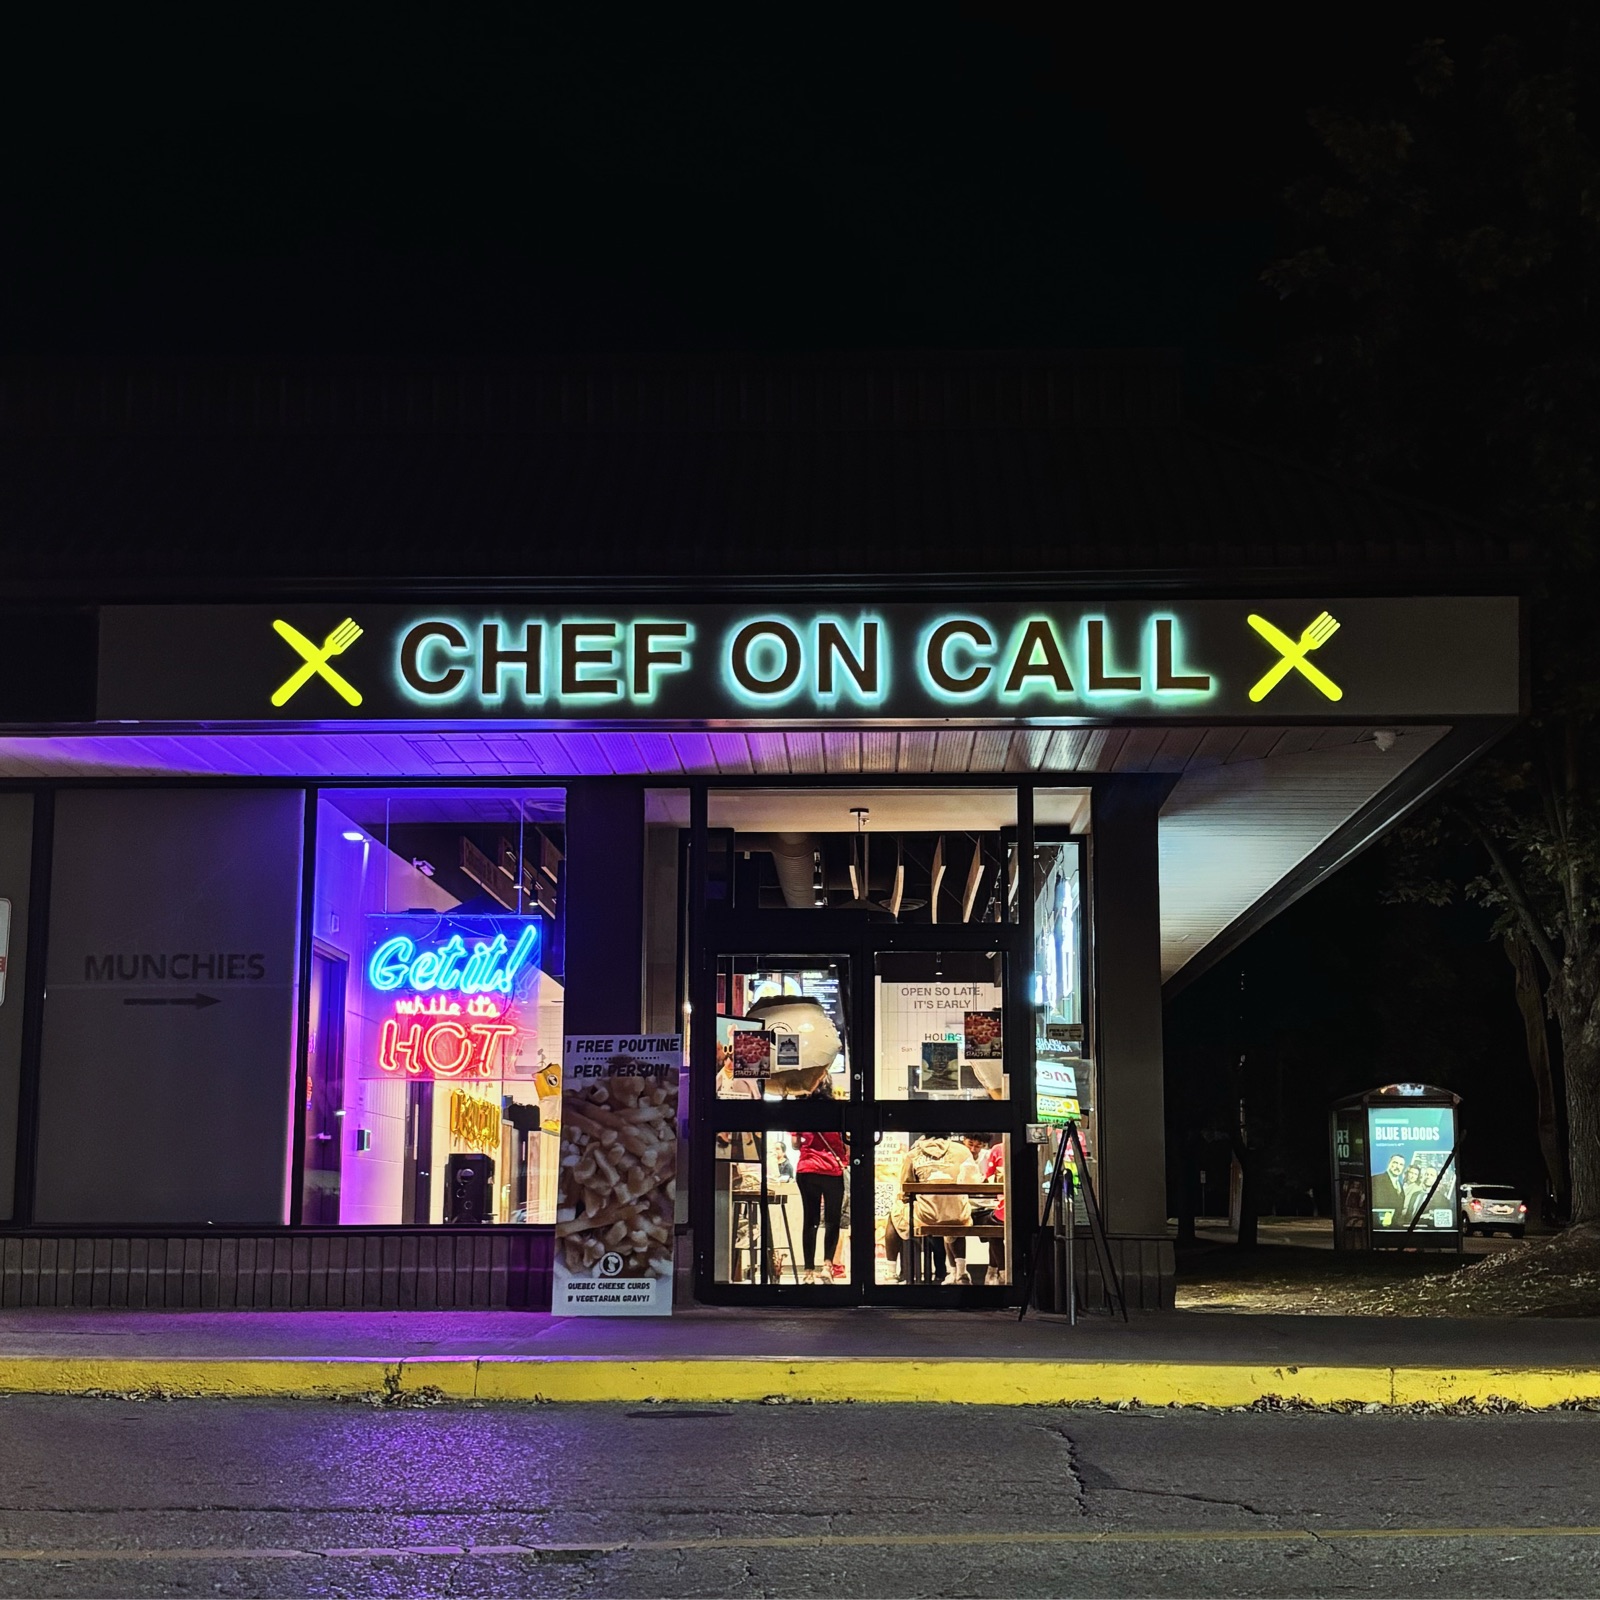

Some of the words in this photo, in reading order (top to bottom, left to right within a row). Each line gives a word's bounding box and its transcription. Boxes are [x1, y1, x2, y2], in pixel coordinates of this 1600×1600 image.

[399, 620, 688, 696] CHEF
[731, 619, 879, 695] ON
[926, 618, 1211, 694] CALL
[84, 953, 266, 981] MUNCHIES
[369, 934, 468, 991] Get
[901, 987, 932, 997] OPEN
[934, 987, 951, 997] SO
[953, 987, 984, 997] LATE,
[395, 995, 461, 1016] while
[467, 995, 500, 1018] it's
[914, 1000, 934, 1009] IT'S
[937, 1000, 971, 1009] EARLY
[924, 1032, 963, 1042] HOURS
[379, 1019, 517, 1077] HOT
[566, 1040, 572, 1053] 1
[575, 1039, 614, 1053] FREE
[618, 1037, 680, 1053] POUTINE
[573, 1064, 603, 1078] PER
[607, 1063, 671, 1077] PERSON!
[1375, 1126, 1400, 1141] BLUE
[1401, 1126, 1440, 1141] BLOODS
[567, 1282, 596, 1290] QUEBEC
[597, 1282, 626, 1290] CHEESE
[627, 1282, 650, 1290] CURDS
[575, 1295, 621, 1303] VEGETARIAN
[622, 1295, 650, 1303] GRAVY!
